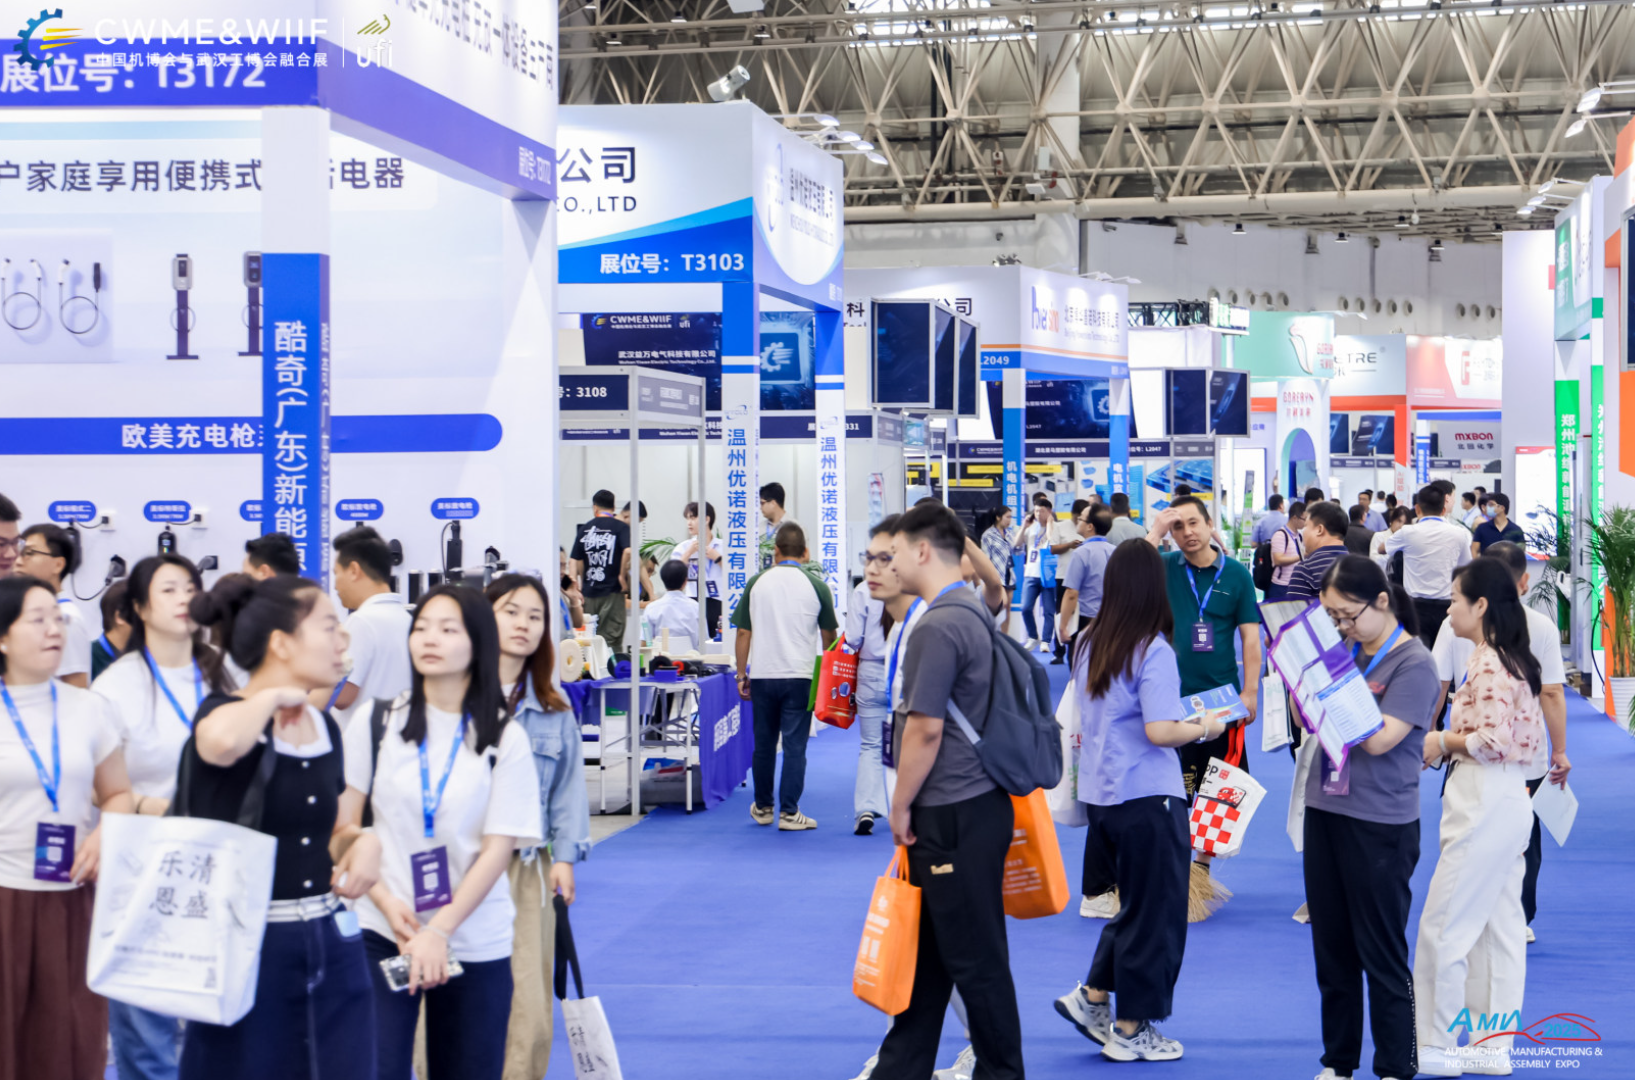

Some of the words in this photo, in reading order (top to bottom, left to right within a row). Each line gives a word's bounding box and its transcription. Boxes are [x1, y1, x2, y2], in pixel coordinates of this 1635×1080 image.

[121, 423, 263, 449] 欧美充电枪
